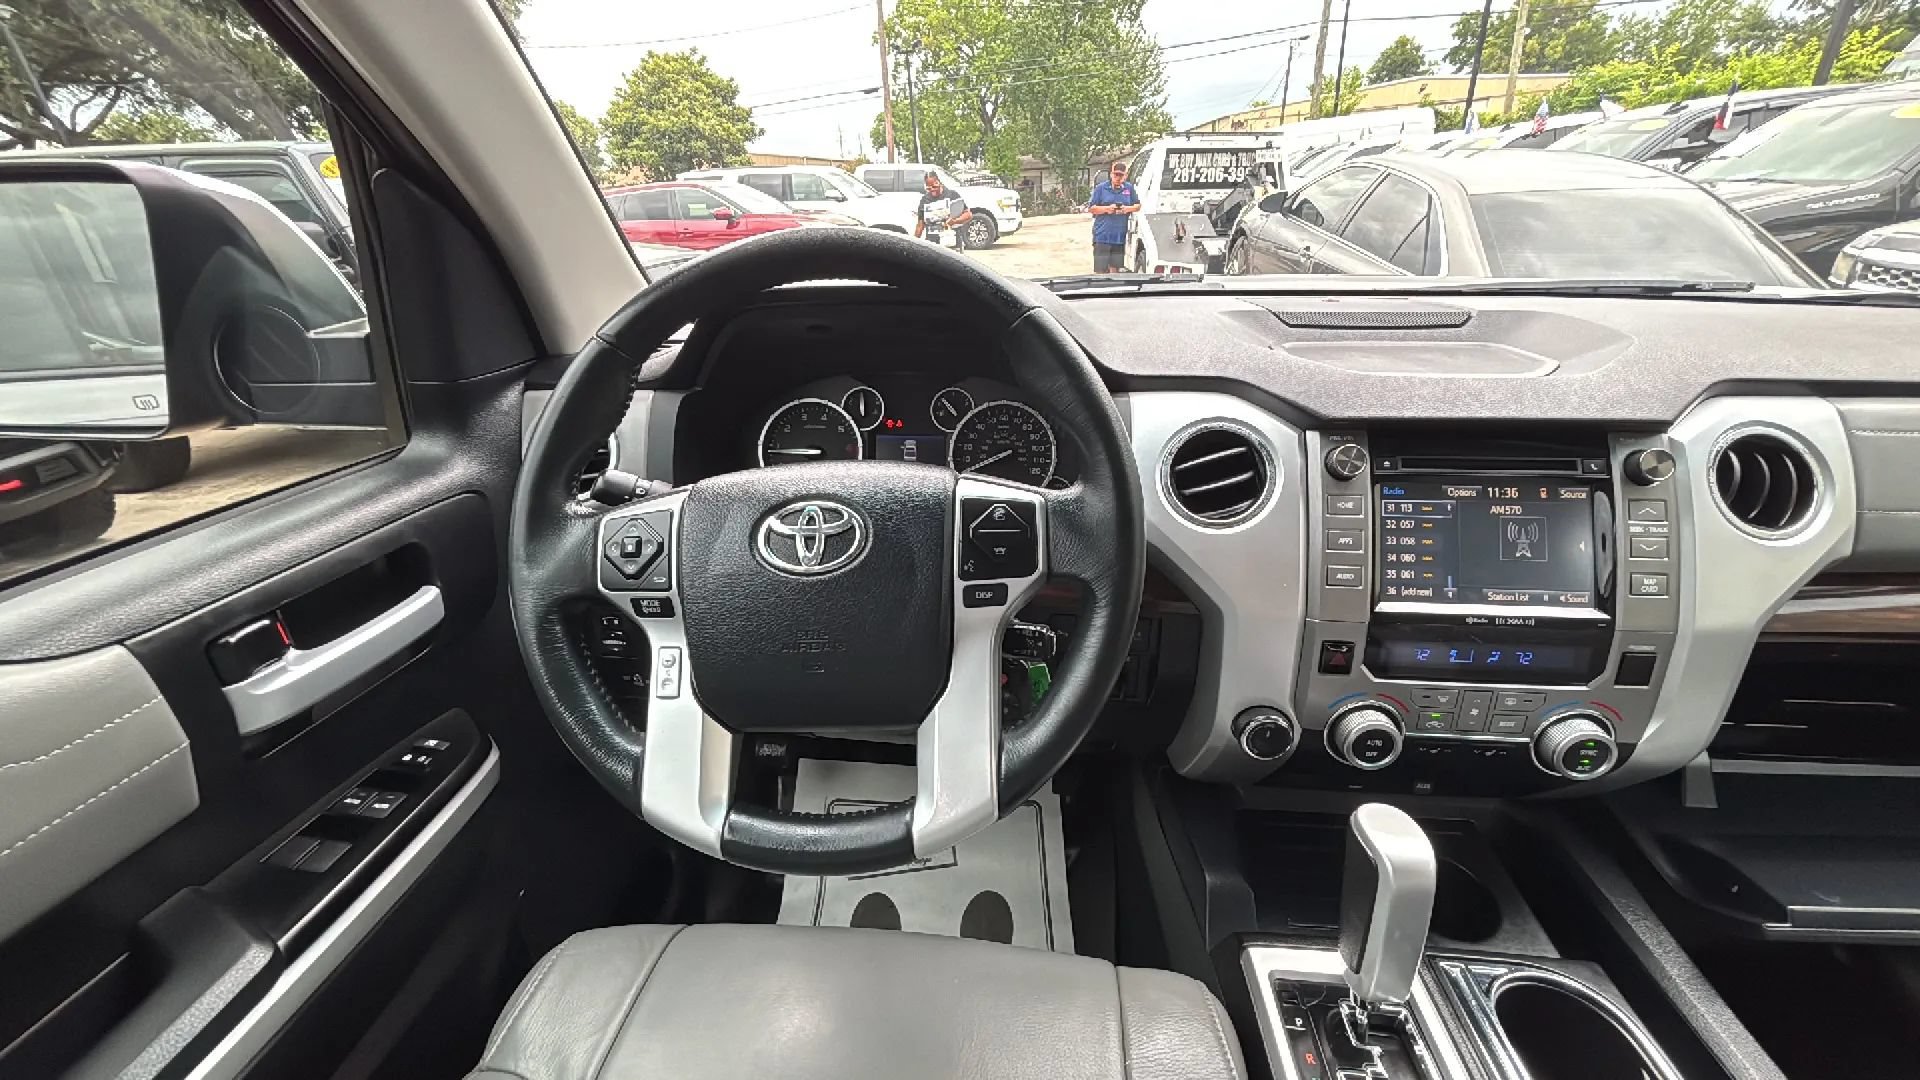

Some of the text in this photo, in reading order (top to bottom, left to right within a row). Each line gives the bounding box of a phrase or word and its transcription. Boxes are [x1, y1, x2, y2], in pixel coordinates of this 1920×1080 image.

[1169, 153, 1180, 168] WE
[1181, 153, 1194, 168] BUY
[1195, 153, 1212, 167] JUNK
[784, 424, 791, 433] 2
[963, 443, 973, 451] 20
[1447, 487, 1477, 498] Options
[1487, 487, 1519, 499] 11:36
[1560, 489, 1587, 499] Source
[1336, 501, 1355, 509] HOME
[1386, 503, 1395, 513] 31
[1400, 504, 1413, 513] 113
[1385, 520, 1397, 529] 32
[1400, 520, 1415, 529] 057
[1337, 537, 1353, 545] APPS
[1385, 537, 1397, 545] 33
[1400, 537, 1416, 546] 058
[1386, 554, 1397, 563] 34
[1386, 570, 1397, 579] 35
[1400, 570, 1415, 579] 061
[1386, 587, 1397, 596] 36
[1640, 585, 1658, 593] CARD
[975, 591, 993, 599] DISP
[1487, 591, 1529, 601] Station List
[1567, 594, 1589, 603] Sound
[1415, 649, 1431, 660] 72
[1516, 652, 1533, 665] 72
[1366, 739, 1383, 747] AUTO
[1296, 1018, 1303, 1027] P
[1305, 1053, 1316, 1065] R
